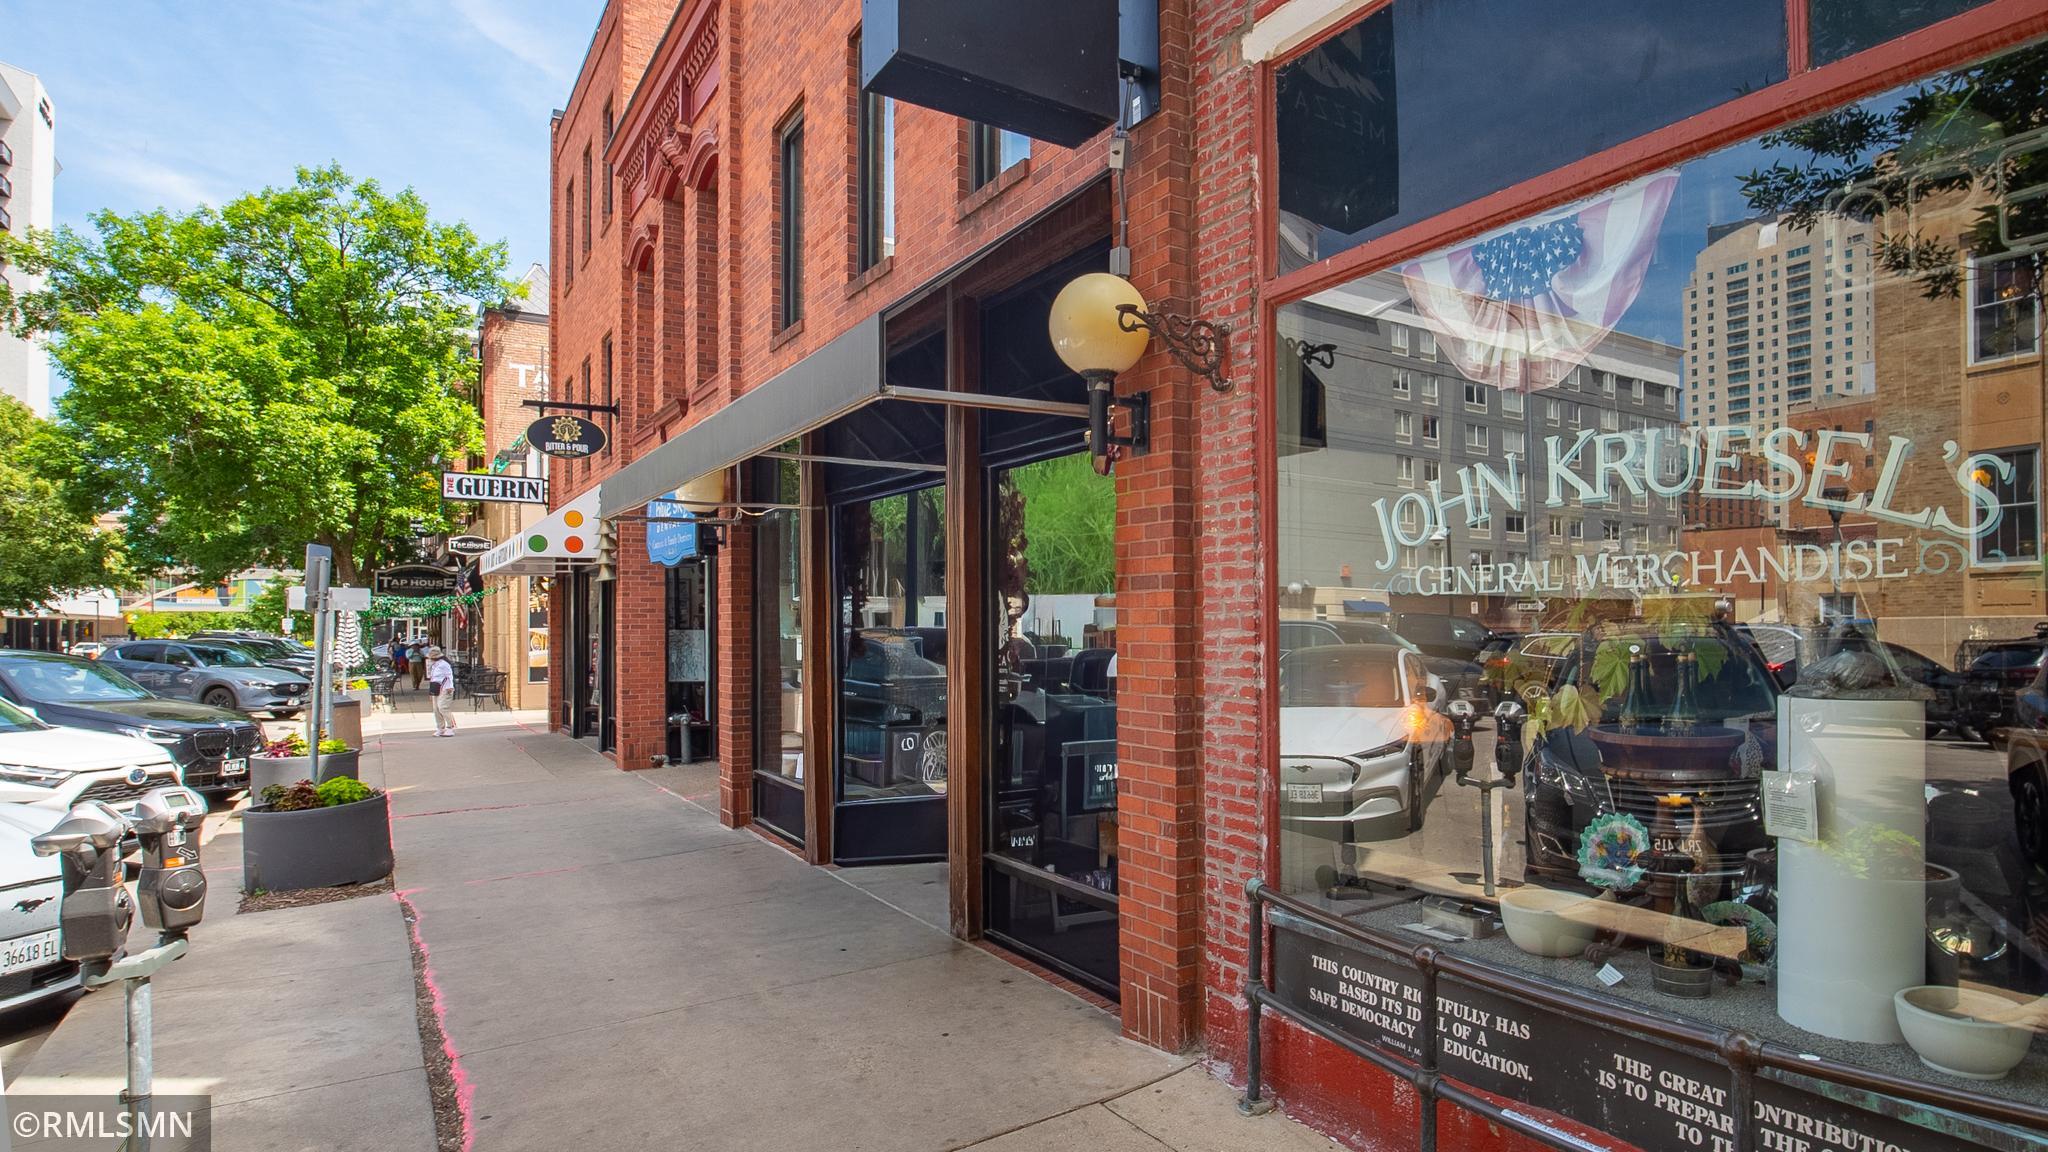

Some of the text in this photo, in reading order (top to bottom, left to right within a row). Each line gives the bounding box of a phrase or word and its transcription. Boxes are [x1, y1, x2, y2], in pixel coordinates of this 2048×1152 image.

[572, 443, 588, 454] POUR
[456, 477, 540, 499] GUERIN
[1371, 425, 2016, 573] JOHN KRUESEL'S
[379, 577, 455, 589] TAP HOUSE
[1415, 538, 1909, 596] GENERAL MERCHANDISE
[3, 940, 58, 967] 36618 EL
[1312, 955, 1531, 1040] THIS COUNTRY RITFULLY HAS
[1339, 981, 1377, 1006] BASED
[1382, 996, 1402, 1015] ITS
[1453, 1022, 1472, 1041] OF
[1477, 1030, 1488, 1047] A
[1309, 987, 1533, 1082] SAFE DEMOCRACY EDUCATION.
[1382, 1034, 1406, 1050] WILLIAM
[1599, 1069, 1616, 1090] IS
[1623, 1078, 1647, 1101] TO
[1654, 1090, 1734, 1135] PREPAR
[1613, 1053, 1652, 1082] THE
[1659, 1071, 1726, 1107] GREAT
[1675, 1120, 1703, 1145] TO
